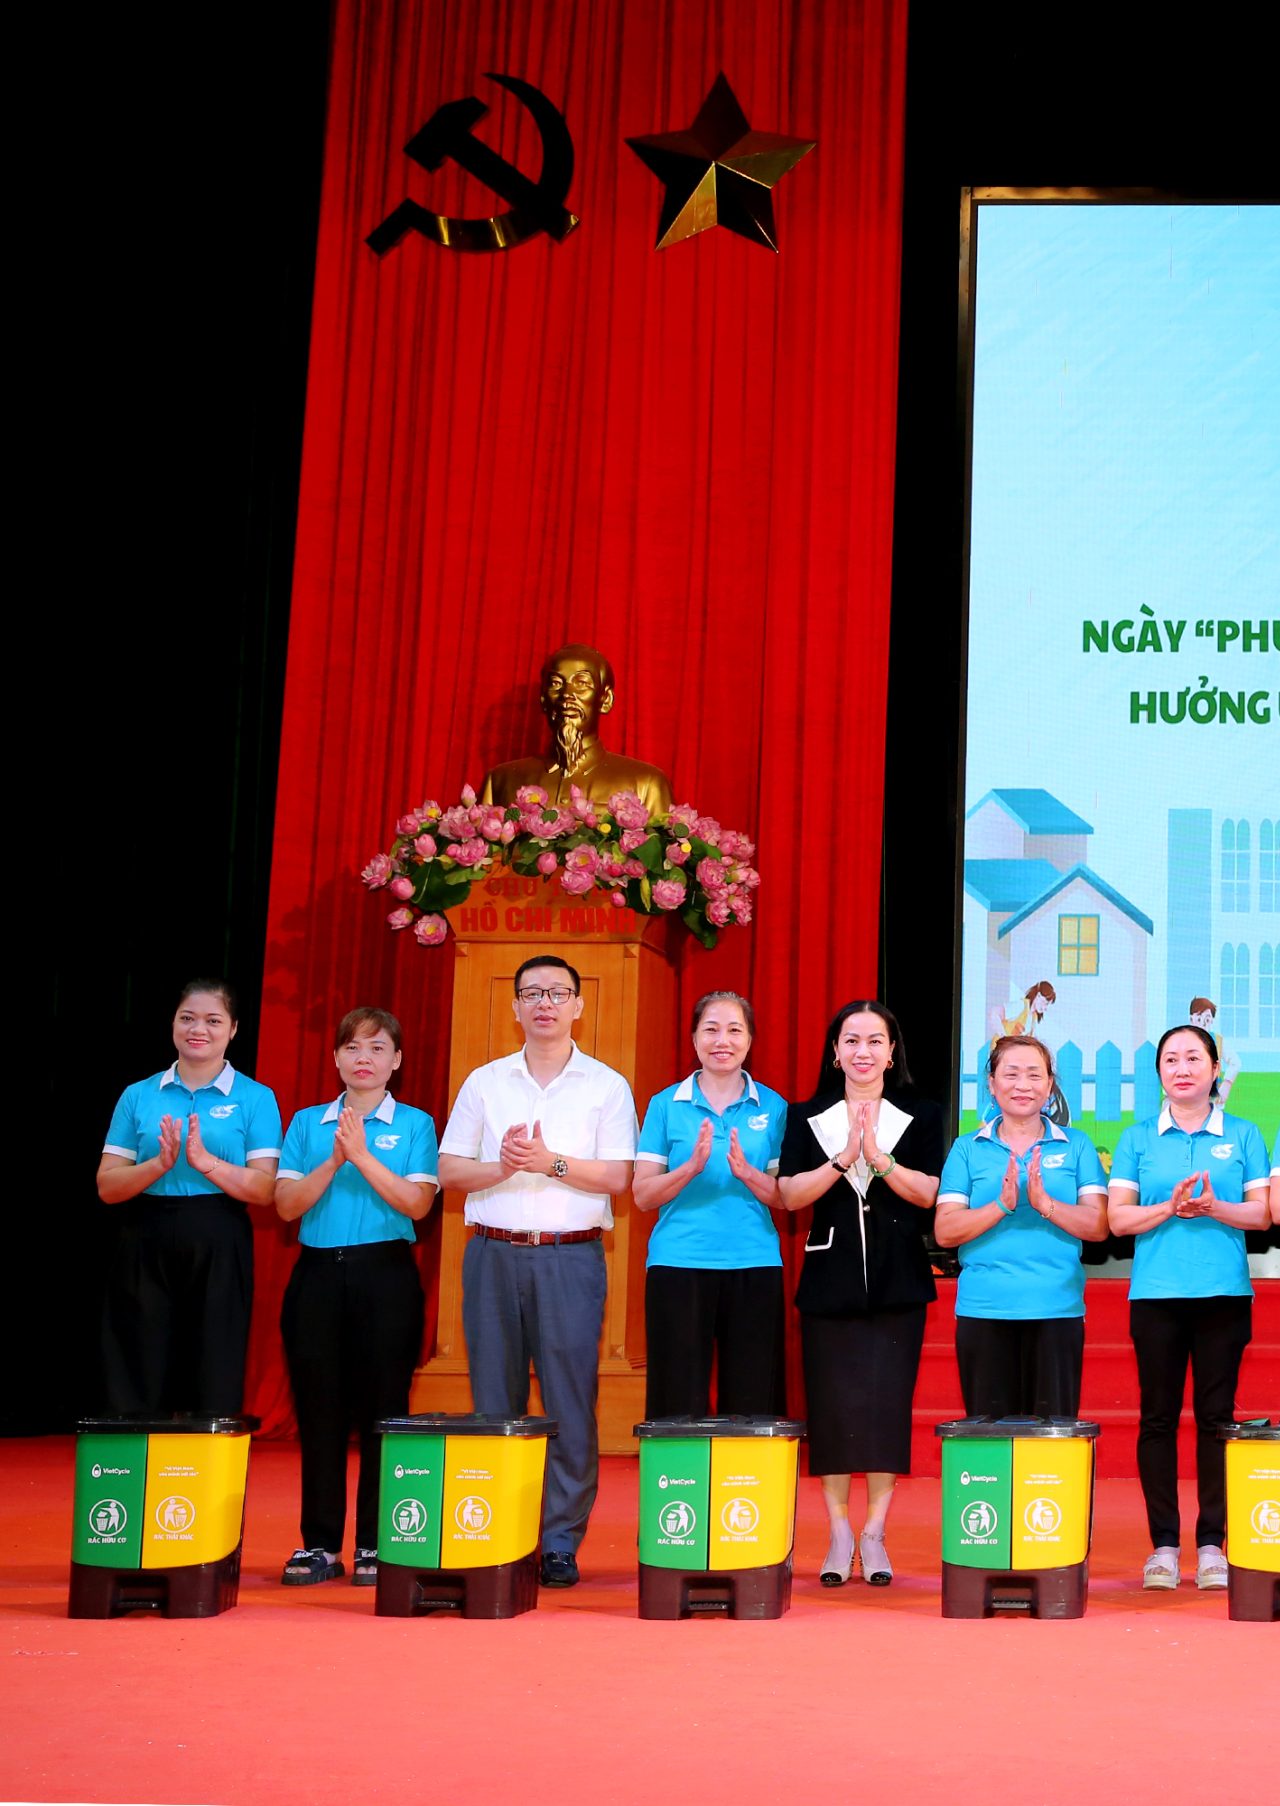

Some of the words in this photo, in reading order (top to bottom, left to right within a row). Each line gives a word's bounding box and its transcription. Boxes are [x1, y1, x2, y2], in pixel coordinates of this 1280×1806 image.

[1083, 605, 1186, 653] NGÀY
[1130, 675, 1271, 725] HƯỞNG
[459, 899, 497, 932] HỒ
[559, 906, 636, 932] MINH
